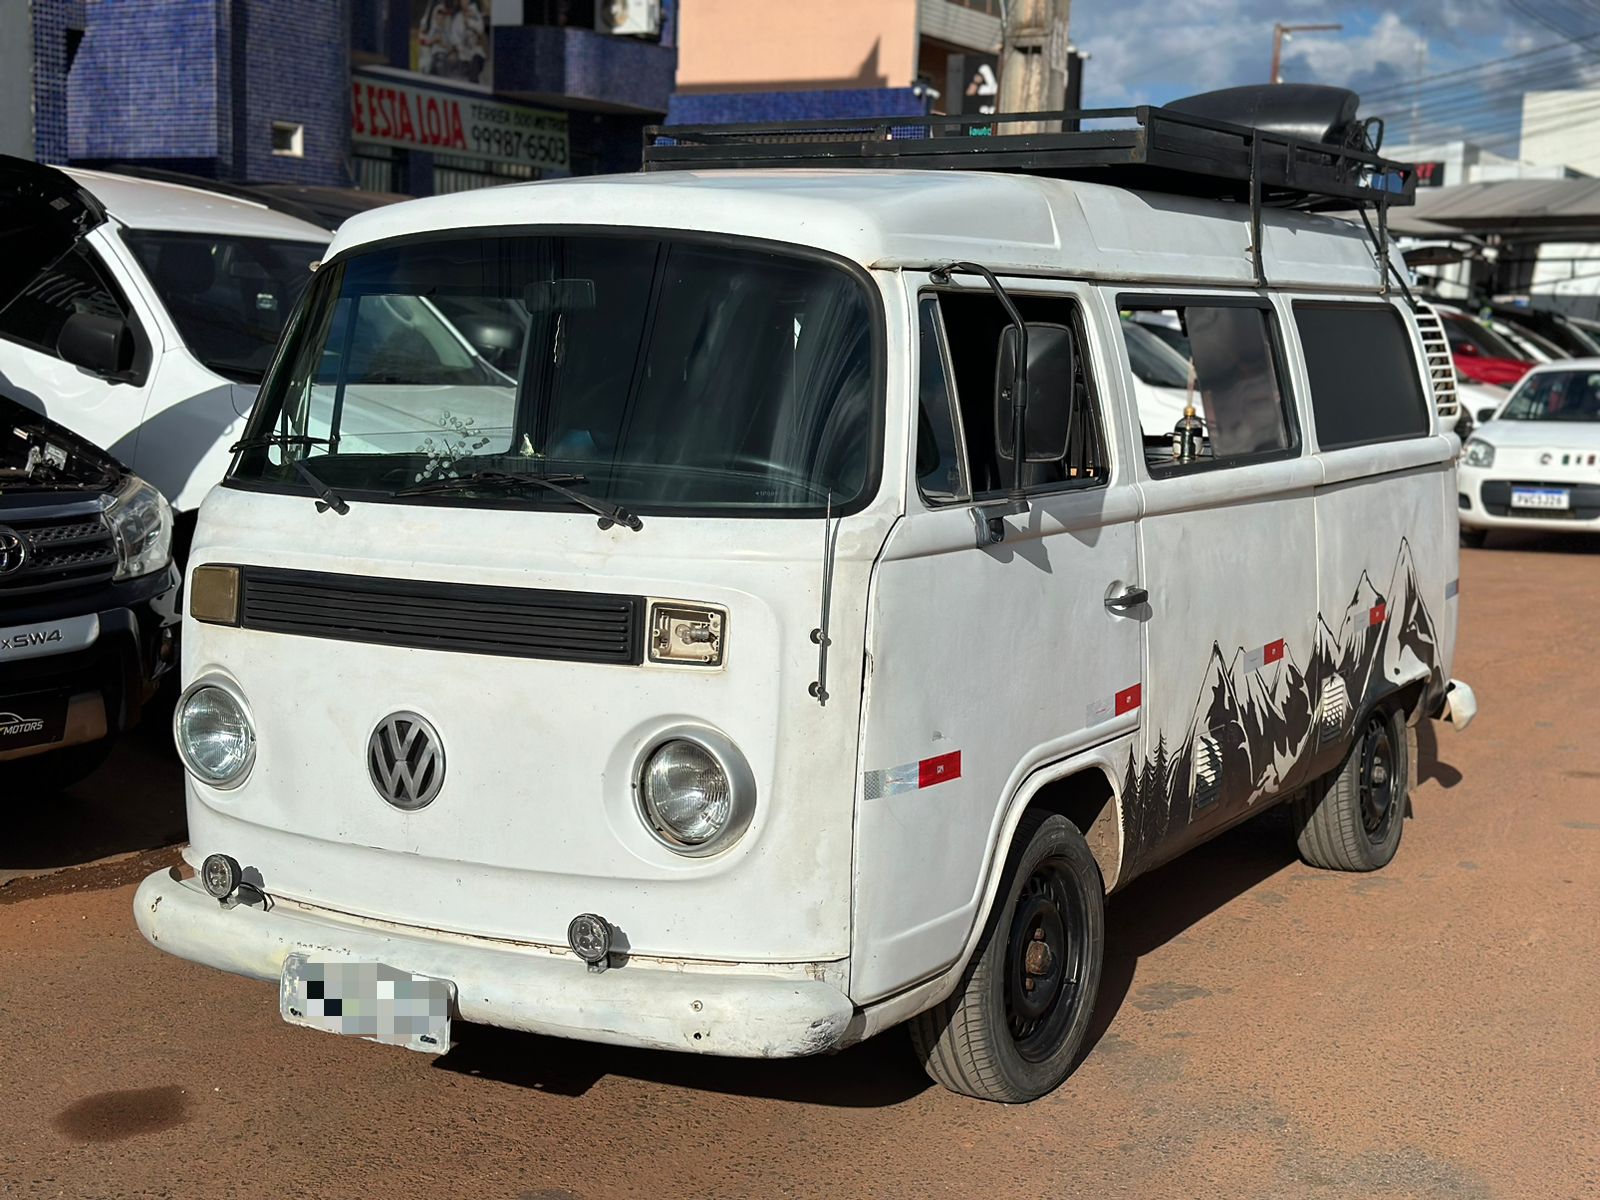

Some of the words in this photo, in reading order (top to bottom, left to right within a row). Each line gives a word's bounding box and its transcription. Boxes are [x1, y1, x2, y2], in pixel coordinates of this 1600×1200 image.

[367, 84, 417, 144] ESTA
[416, 94, 468, 149] LOJA
[472, 124, 567, 165] 99987-6503
[3, 720, 44, 736] MOTORS
[368, 712, 445, 810] VW
